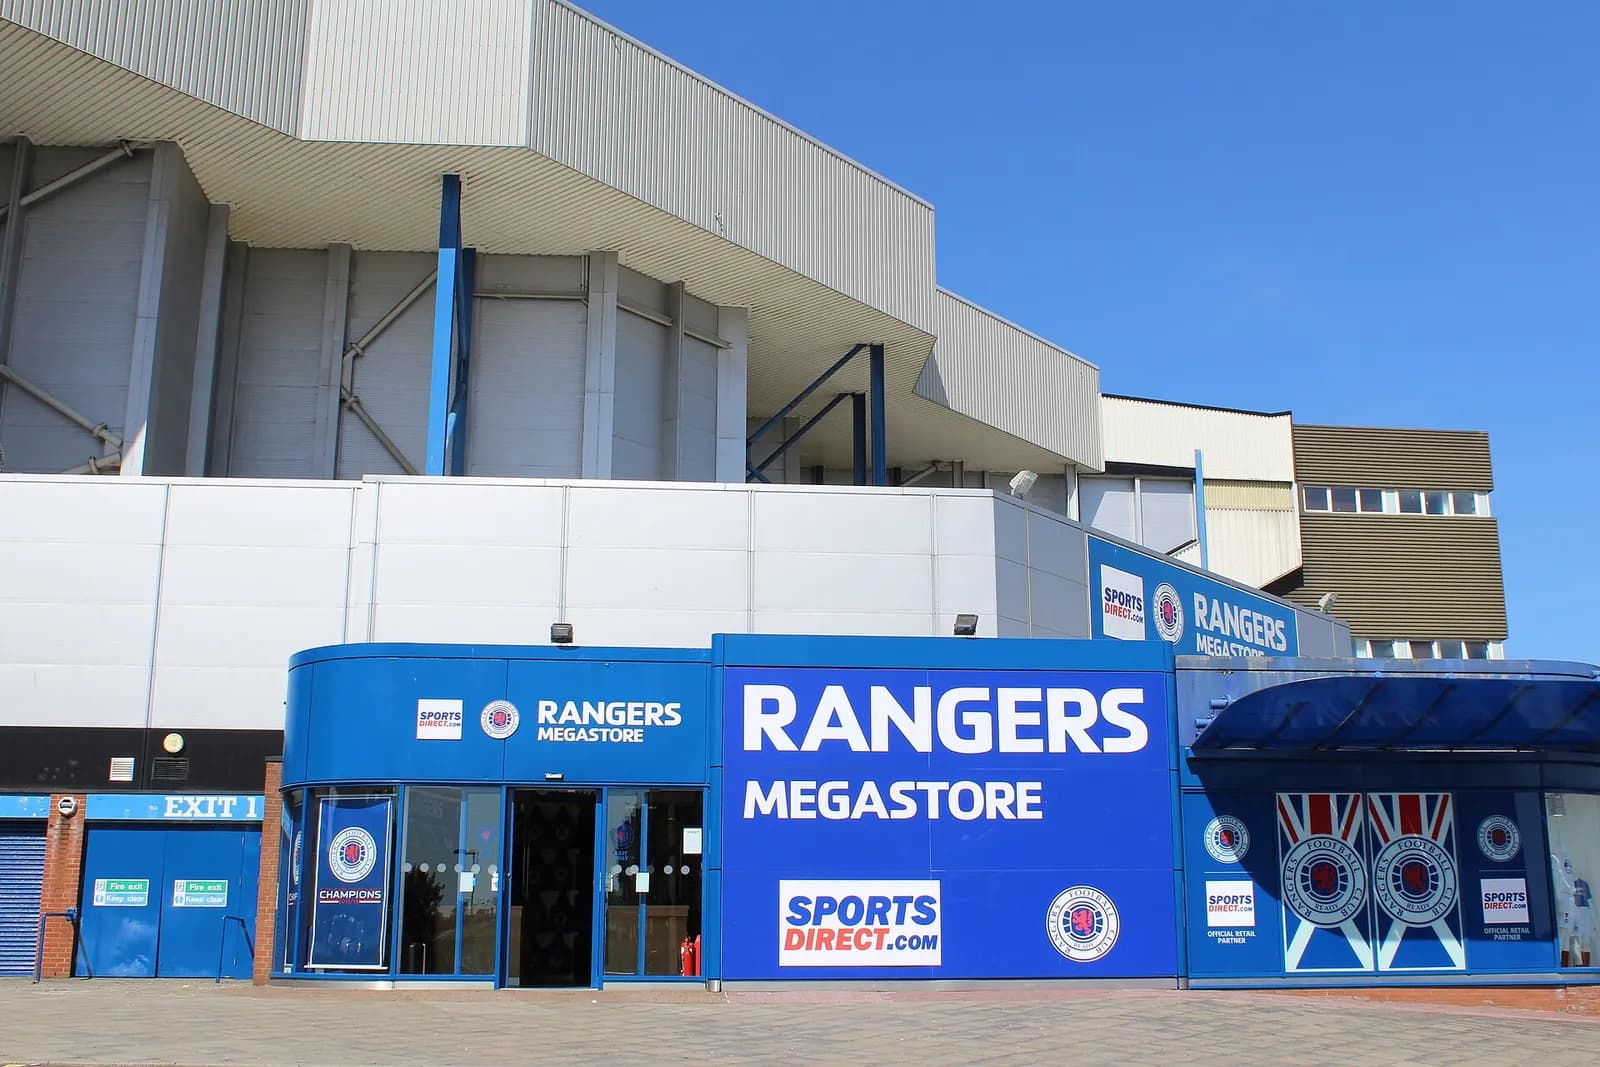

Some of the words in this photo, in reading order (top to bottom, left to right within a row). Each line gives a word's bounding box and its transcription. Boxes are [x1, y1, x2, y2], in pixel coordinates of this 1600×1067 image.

[1104, 586, 1143, 612] SPORTS
[1104, 602, 1144, 624] DIRECT.COM
[1193, 592, 1287, 652] RANGERS
[419, 711, 461, 721] SPORTS
[537, 700, 682, 726] RANGERS
[743, 684, 1149, 754] RANGERS
[537, 727, 643, 743] MEGASTORE
[164, 796, 237, 817] EXIT
[247, 796, 257, 817] 1
[743, 780, 1043, 820] MEGASTORE
[1307, 840, 1360, 873] FOOTBALL
[1397, 840, 1452, 872] FOOTBALL
[106, 895, 124, 903] Keep
[128, 883, 143, 891] exit
[186, 896, 204, 904] Keep
[319, 890, 382, 899] CHAMPIONS
[1208, 895, 1252, 905] SPORTS
[1285, 858, 1312, 918] RANGERS
[1376, 857, 1404, 917] RANGERS
[1484, 892, 1526, 902] SPORTS
[786, 894, 937, 927] SPORTS
[1340, 888, 1363, 917] CLUB
[1432, 887, 1453, 917] CLUB
[784, 927, 938, 951] DIRECT.COM
